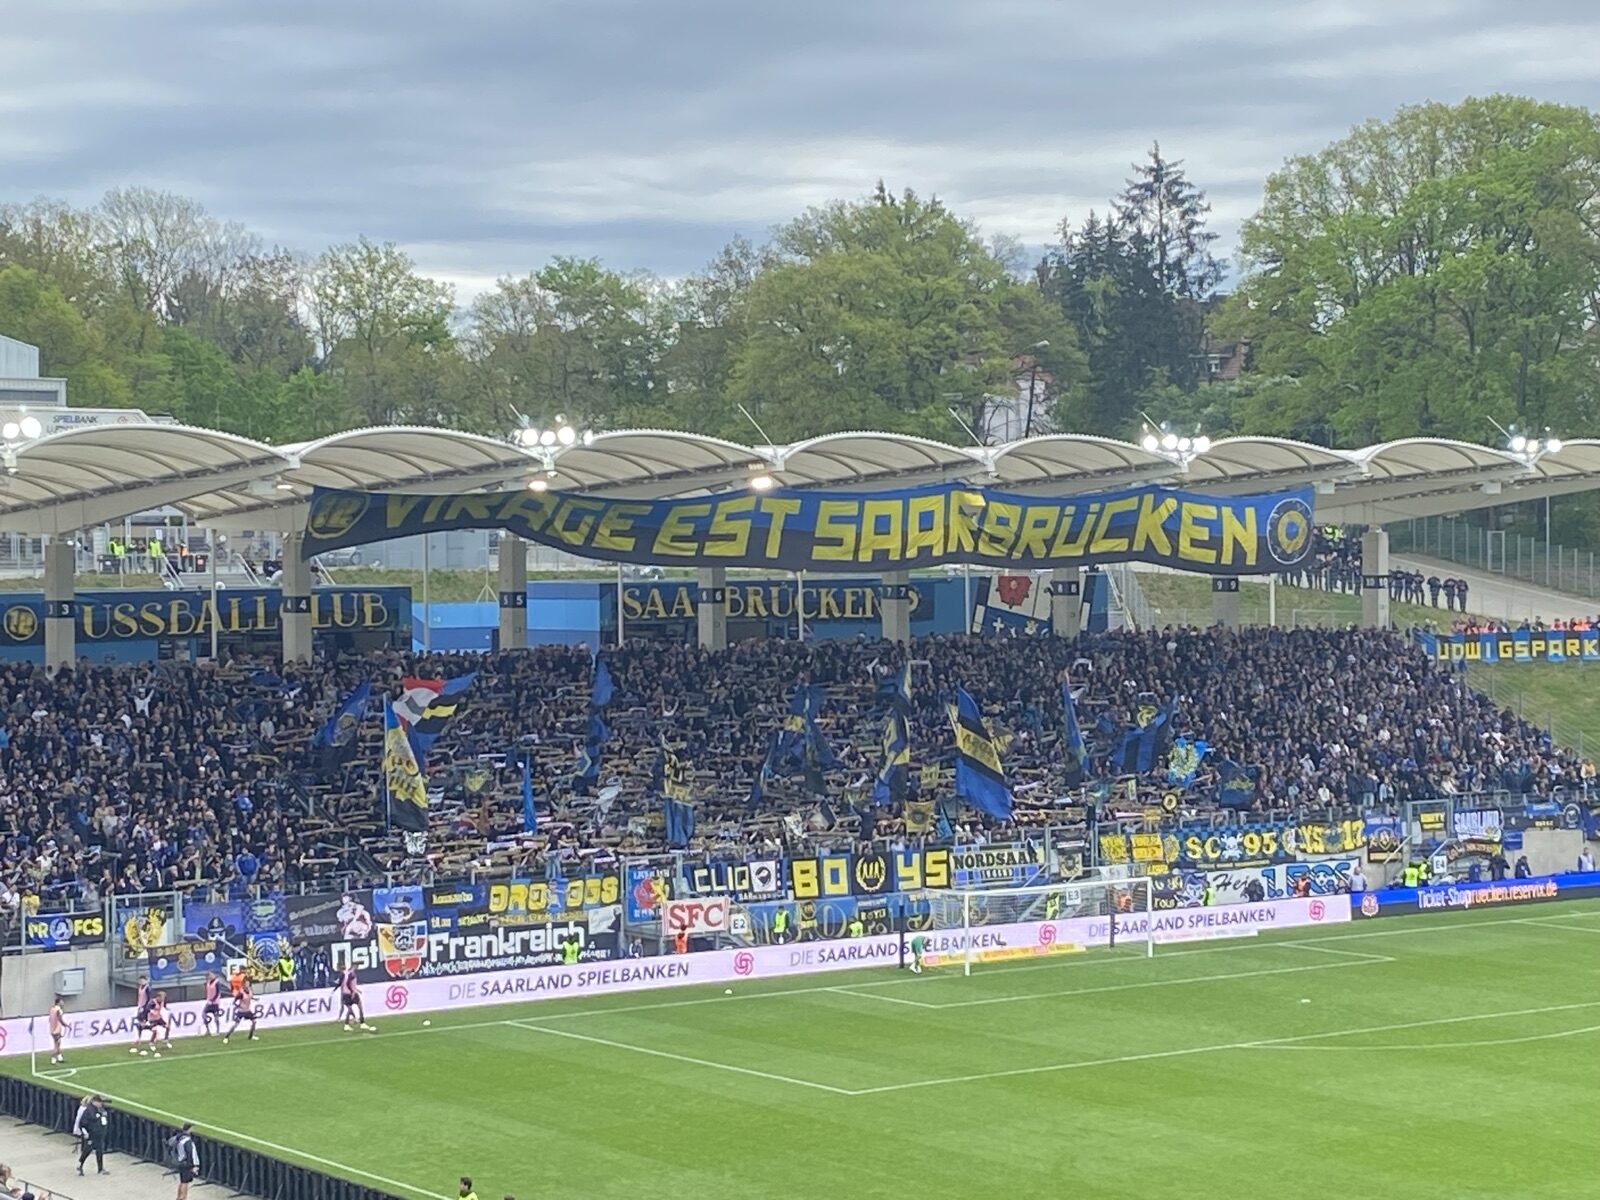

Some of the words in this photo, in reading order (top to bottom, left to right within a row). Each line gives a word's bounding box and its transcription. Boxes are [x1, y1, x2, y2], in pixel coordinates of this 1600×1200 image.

[53, 415, 98, 424] SPIELBANK
[386, 491, 653, 552] VIRAGE
[653, 496, 802, 558] EST
[812, 490, 1258, 565] SAARBRÜCKEN
[61, 603, 70, 615] 3
[299, 599, 307, 610] 4
[516, 594, 524, 605] 5
[623, 582, 885, 620] SAABRÜCKEN
[75, 596, 278, 638] USSBALL
[279, 592, 388, 629] LUB
[1243, 832, 1278, 856] 95
[1067, 891, 1079, 900] E3
[74, 918, 104, 936] FCS
[669, 903, 723, 929] SFC
[733, 918, 746, 929] E2
[1088, 923, 1108, 938] DIE
[1188, 908, 1276, 928] SPIELBANKEN
[331, 939, 378, 972] Ost
[790, 951, 814, 967] DIE
[817, 943, 899, 963] SAARLAND
[450, 981, 476, 1000] DIE
[480, 973, 573, 996] SAARLAND
[577, 962, 689, 987] SPIELBANKEN
